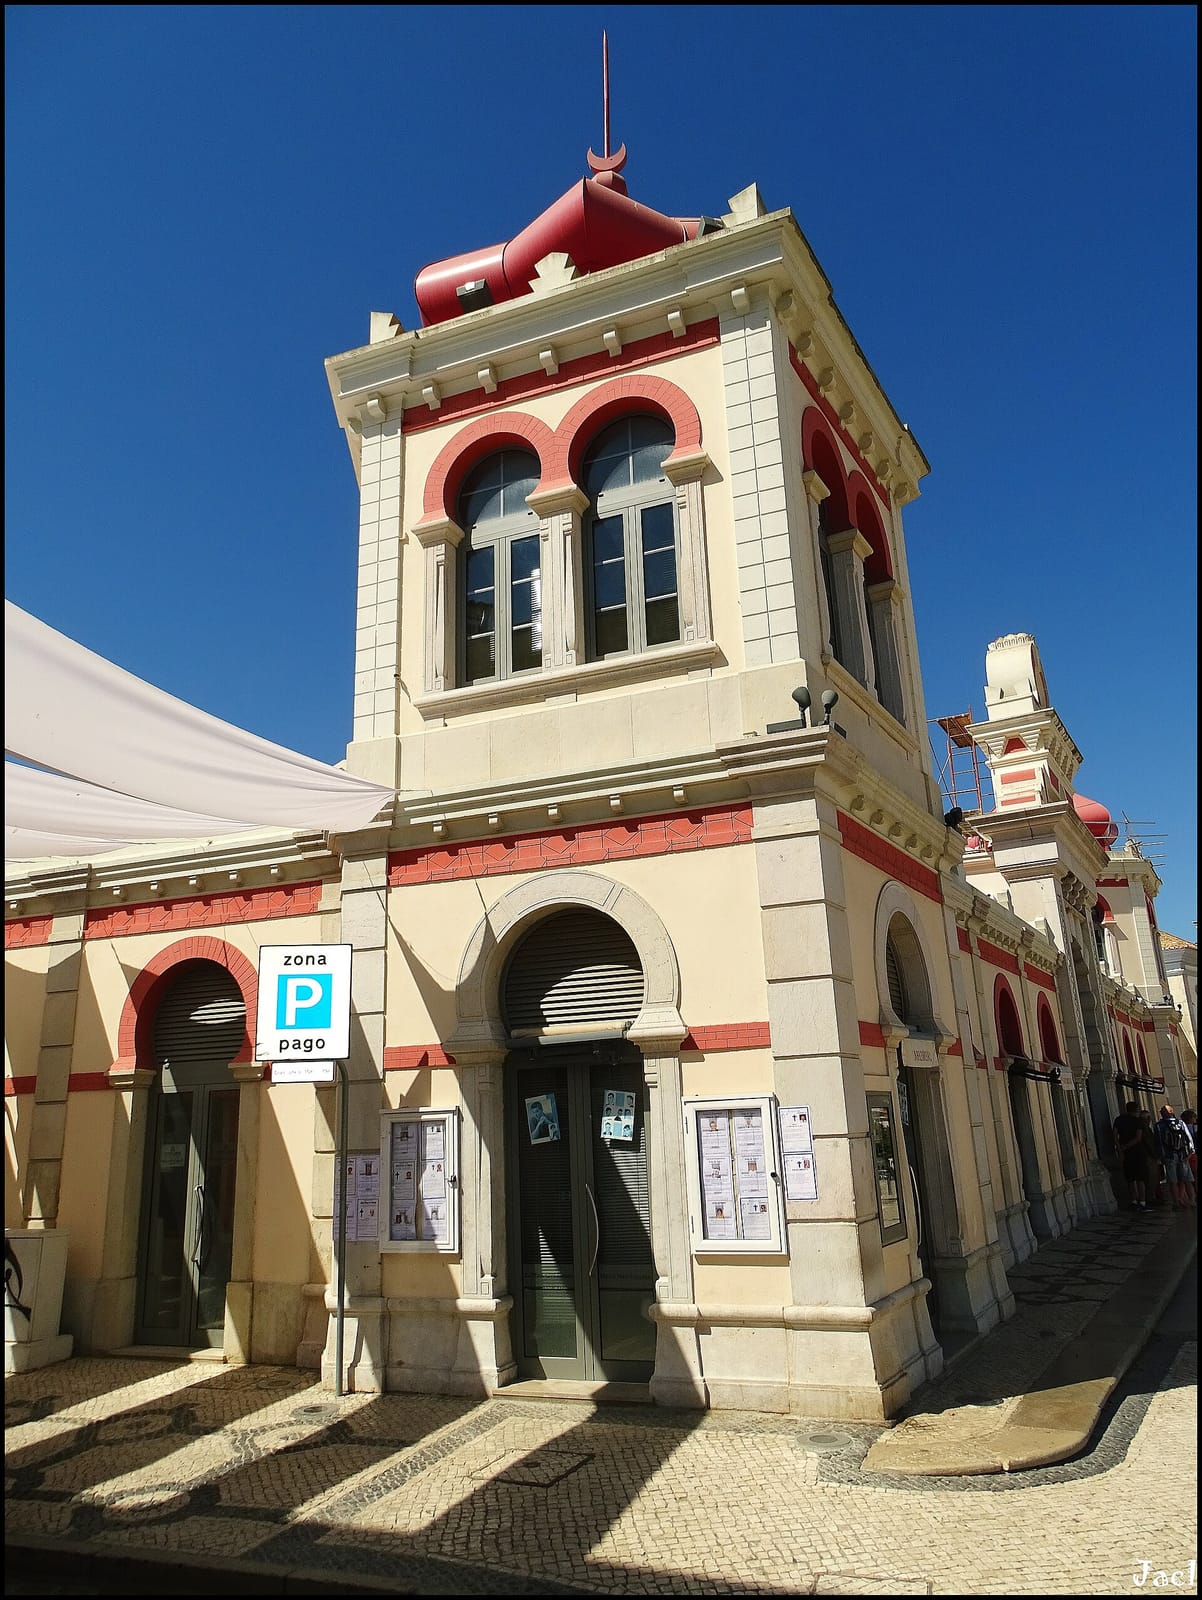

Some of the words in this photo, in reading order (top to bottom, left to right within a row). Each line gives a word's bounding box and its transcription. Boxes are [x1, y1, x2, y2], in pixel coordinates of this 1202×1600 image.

[283, 954, 327, 966] zona
[285, 977, 323, 1026] P
[279, 1038, 326, 1053] pago
